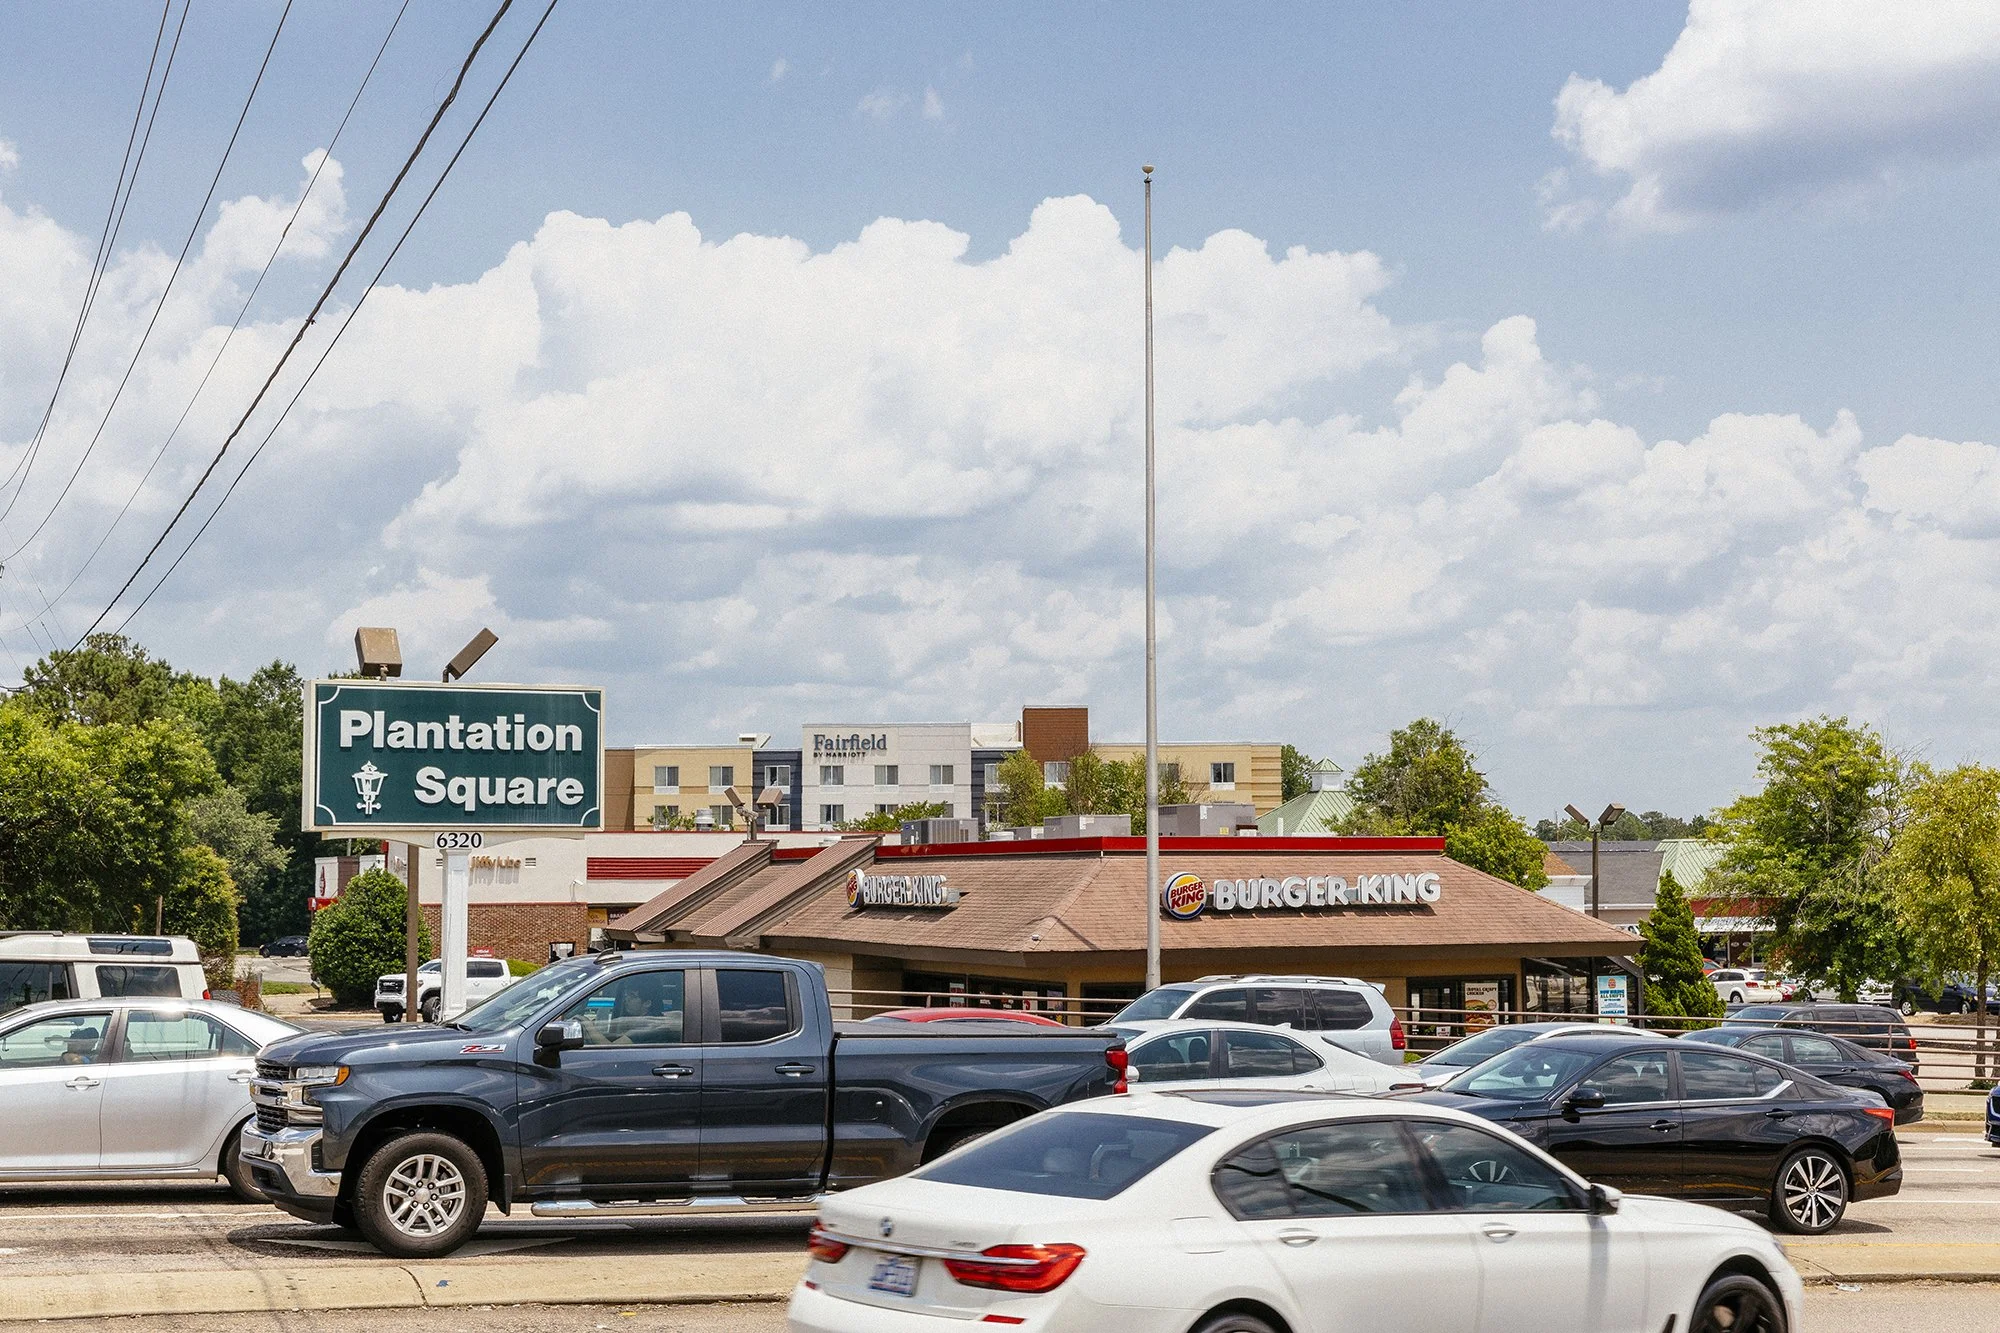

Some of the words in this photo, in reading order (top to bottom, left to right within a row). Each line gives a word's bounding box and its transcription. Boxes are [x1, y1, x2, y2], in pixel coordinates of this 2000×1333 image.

[339, 709, 583, 752] Plantation
[813, 733, 887, 751] Fairfield
[414, 766, 584, 811] Square
[436, 832, 482, 848] 6320
[863, 874, 912, 904] BURGER
[912, 874, 945, 905] KING
[1170, 881, 1204, 900] BURGER
[1171, 889, 1205, 910] KING
[1213, 875, 1349, 910] BURGER
[1358, 872, 1441, 905] KING
